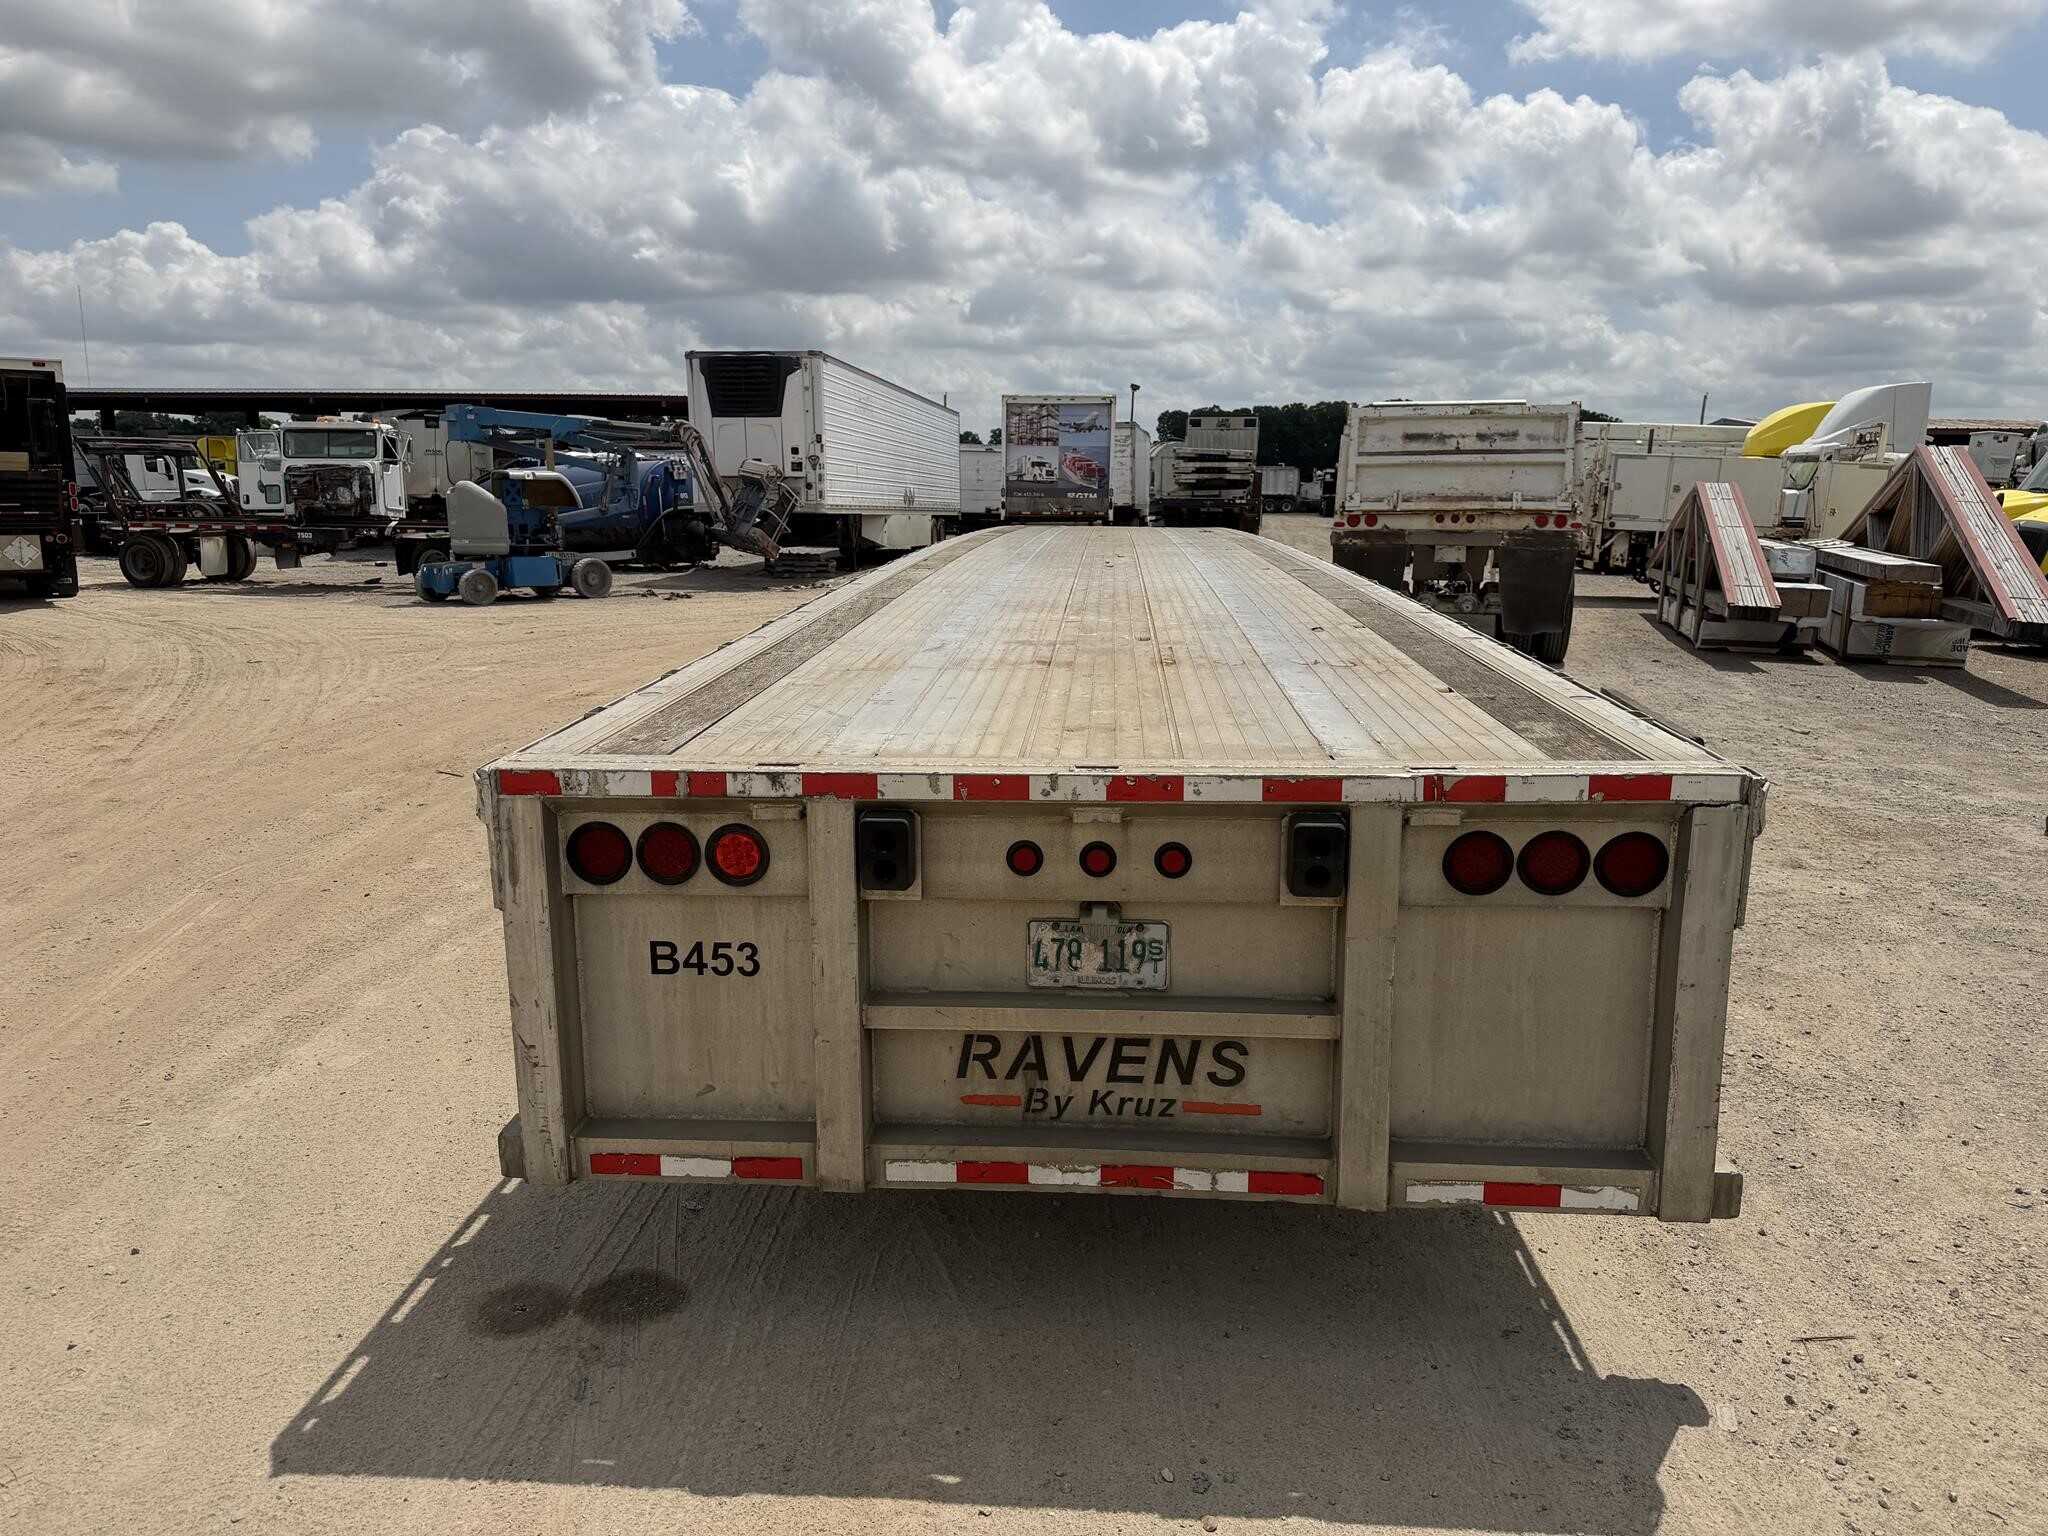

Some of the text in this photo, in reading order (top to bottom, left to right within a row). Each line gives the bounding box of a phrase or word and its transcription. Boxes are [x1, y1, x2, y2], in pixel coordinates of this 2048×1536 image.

[649, 940, 761, 977] B453
[1097, 938, 1146, 974] 119
[956, 1033, 1249, 1087] RAVENS
[1023, 1087, 1177, 1120] By Kruz
